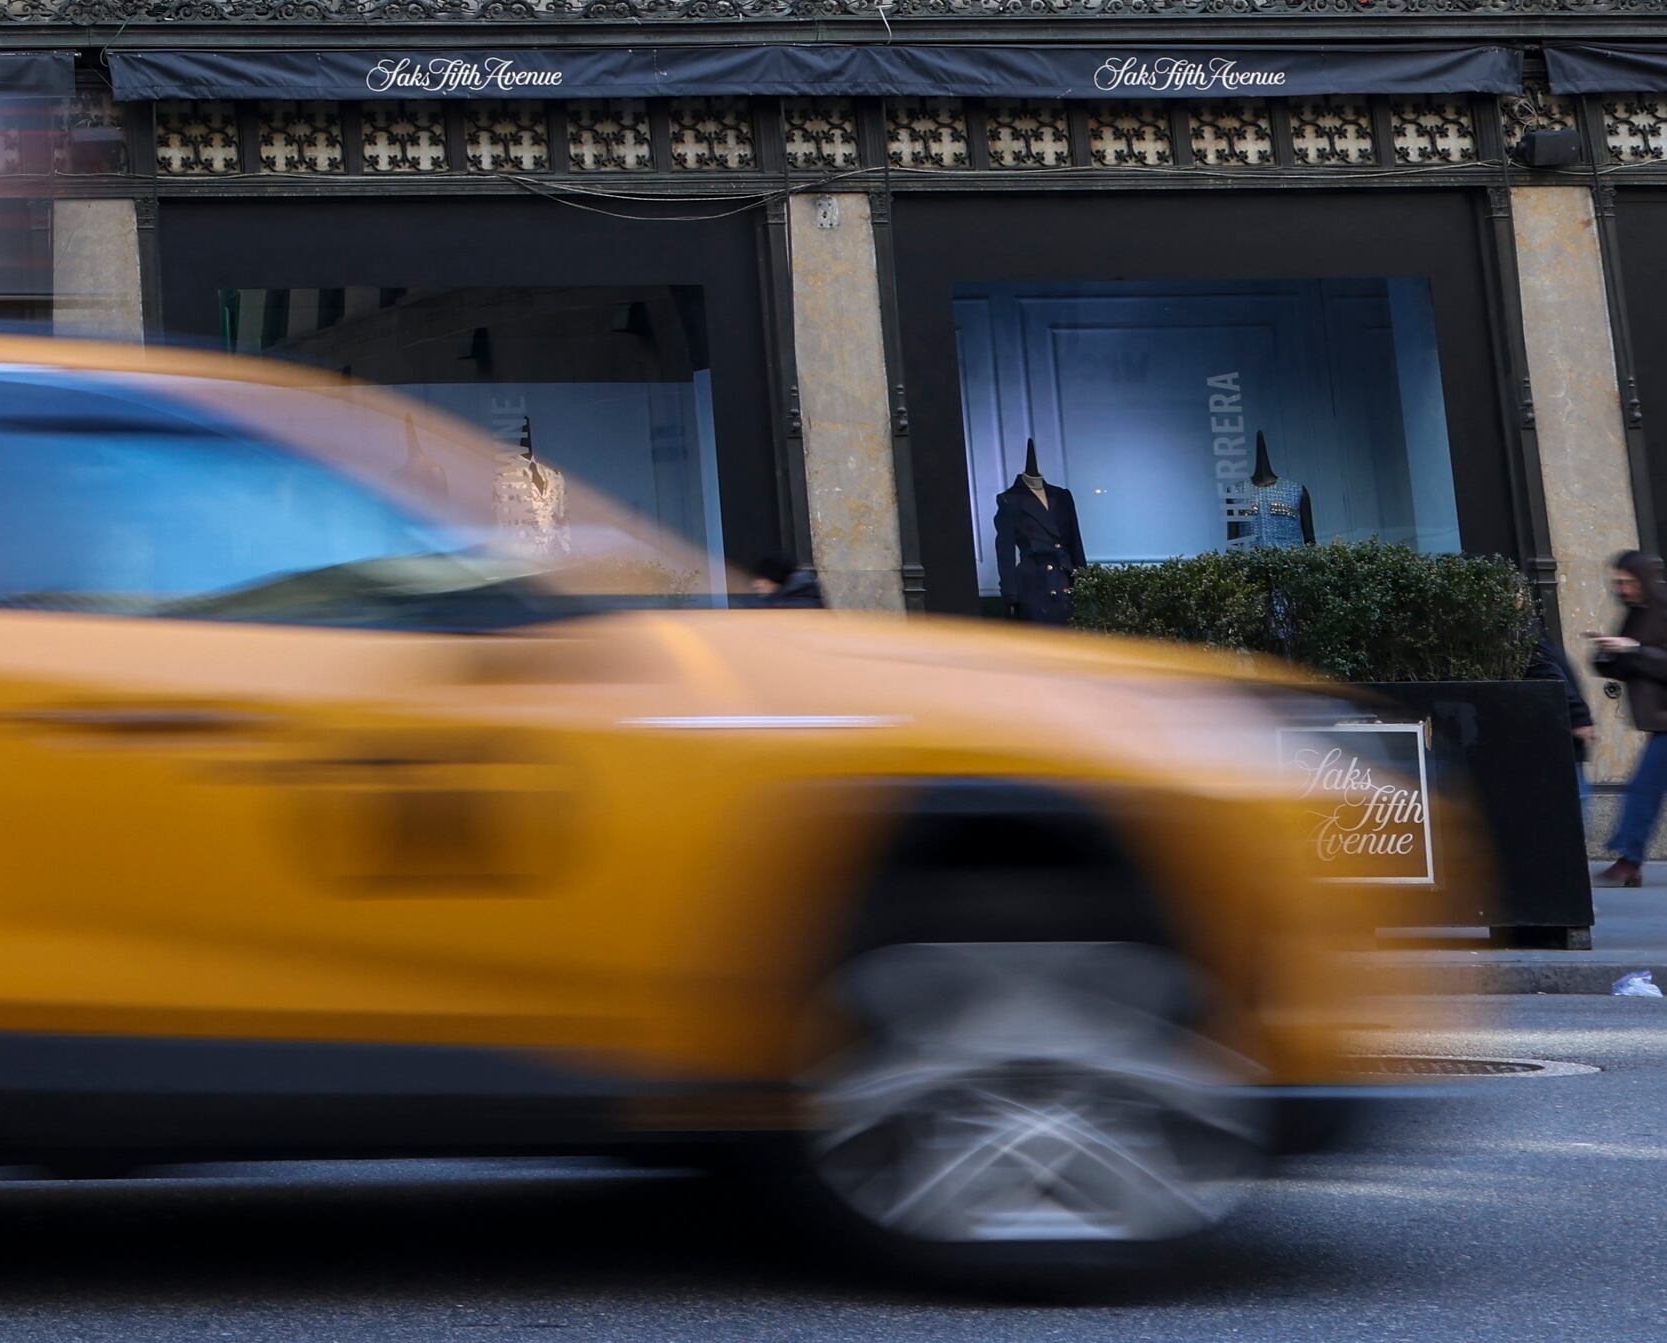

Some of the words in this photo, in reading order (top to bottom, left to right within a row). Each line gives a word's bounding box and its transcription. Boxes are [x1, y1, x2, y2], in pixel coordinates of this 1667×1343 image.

[366, 58, 430, 92] Saks
[423, 58, 482, 91] Fifth
[469, 57, 563, 90] Avenue
[1094, 57, 1157, 91] Saks
[1150, 57, 1208, 91] Fifth
[1195, 57, 1286, 90] Avenue
[1289, 747, 1372, 800] Saks
[1334, 782, 1425, 832] Fifth
[1298, 810, 1414, 862] Avenue
